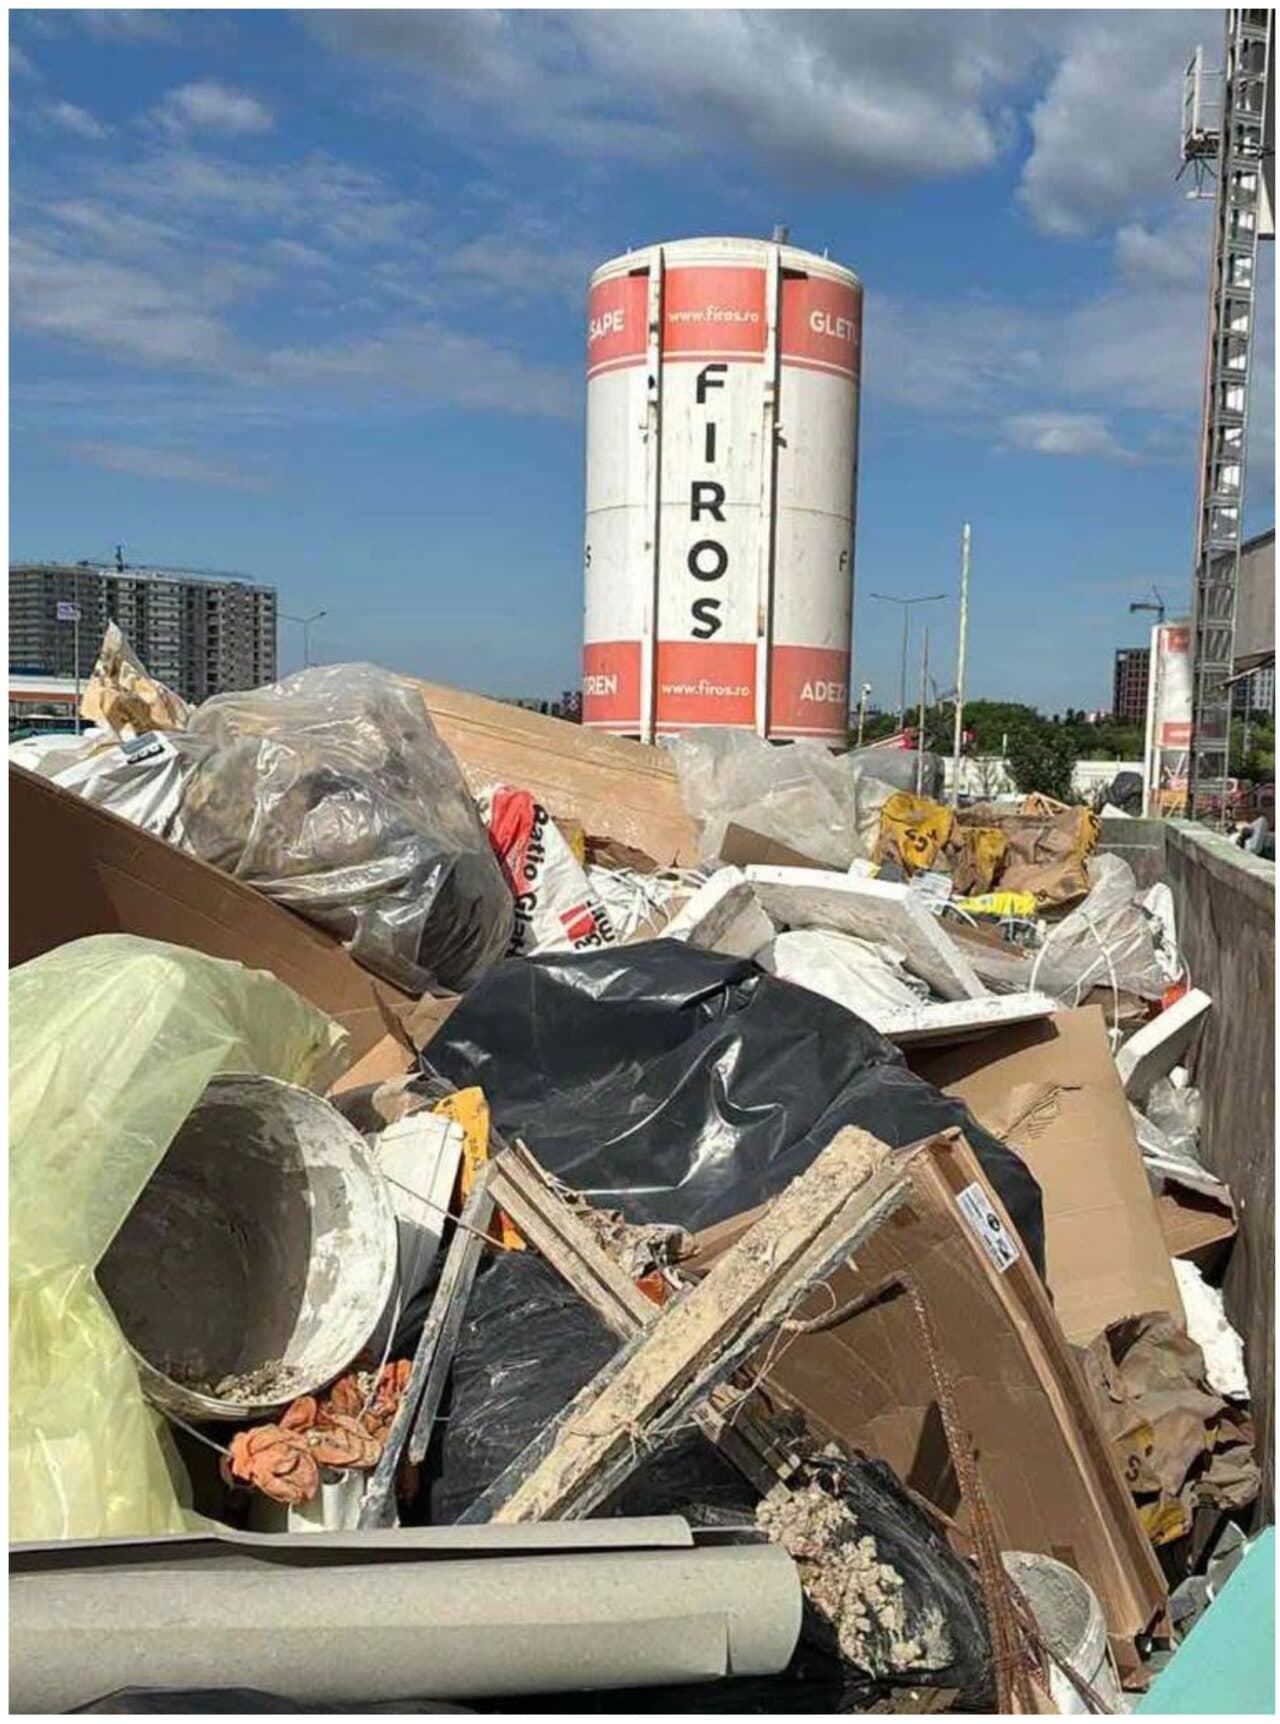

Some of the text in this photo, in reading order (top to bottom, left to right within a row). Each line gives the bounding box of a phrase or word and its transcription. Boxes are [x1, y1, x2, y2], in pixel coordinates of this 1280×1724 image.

[669, 304, 760, 323] www.firos.ro
[687, 363, 729, 639] FIROS
[661, 680, 750, 697] www.firos.ro
